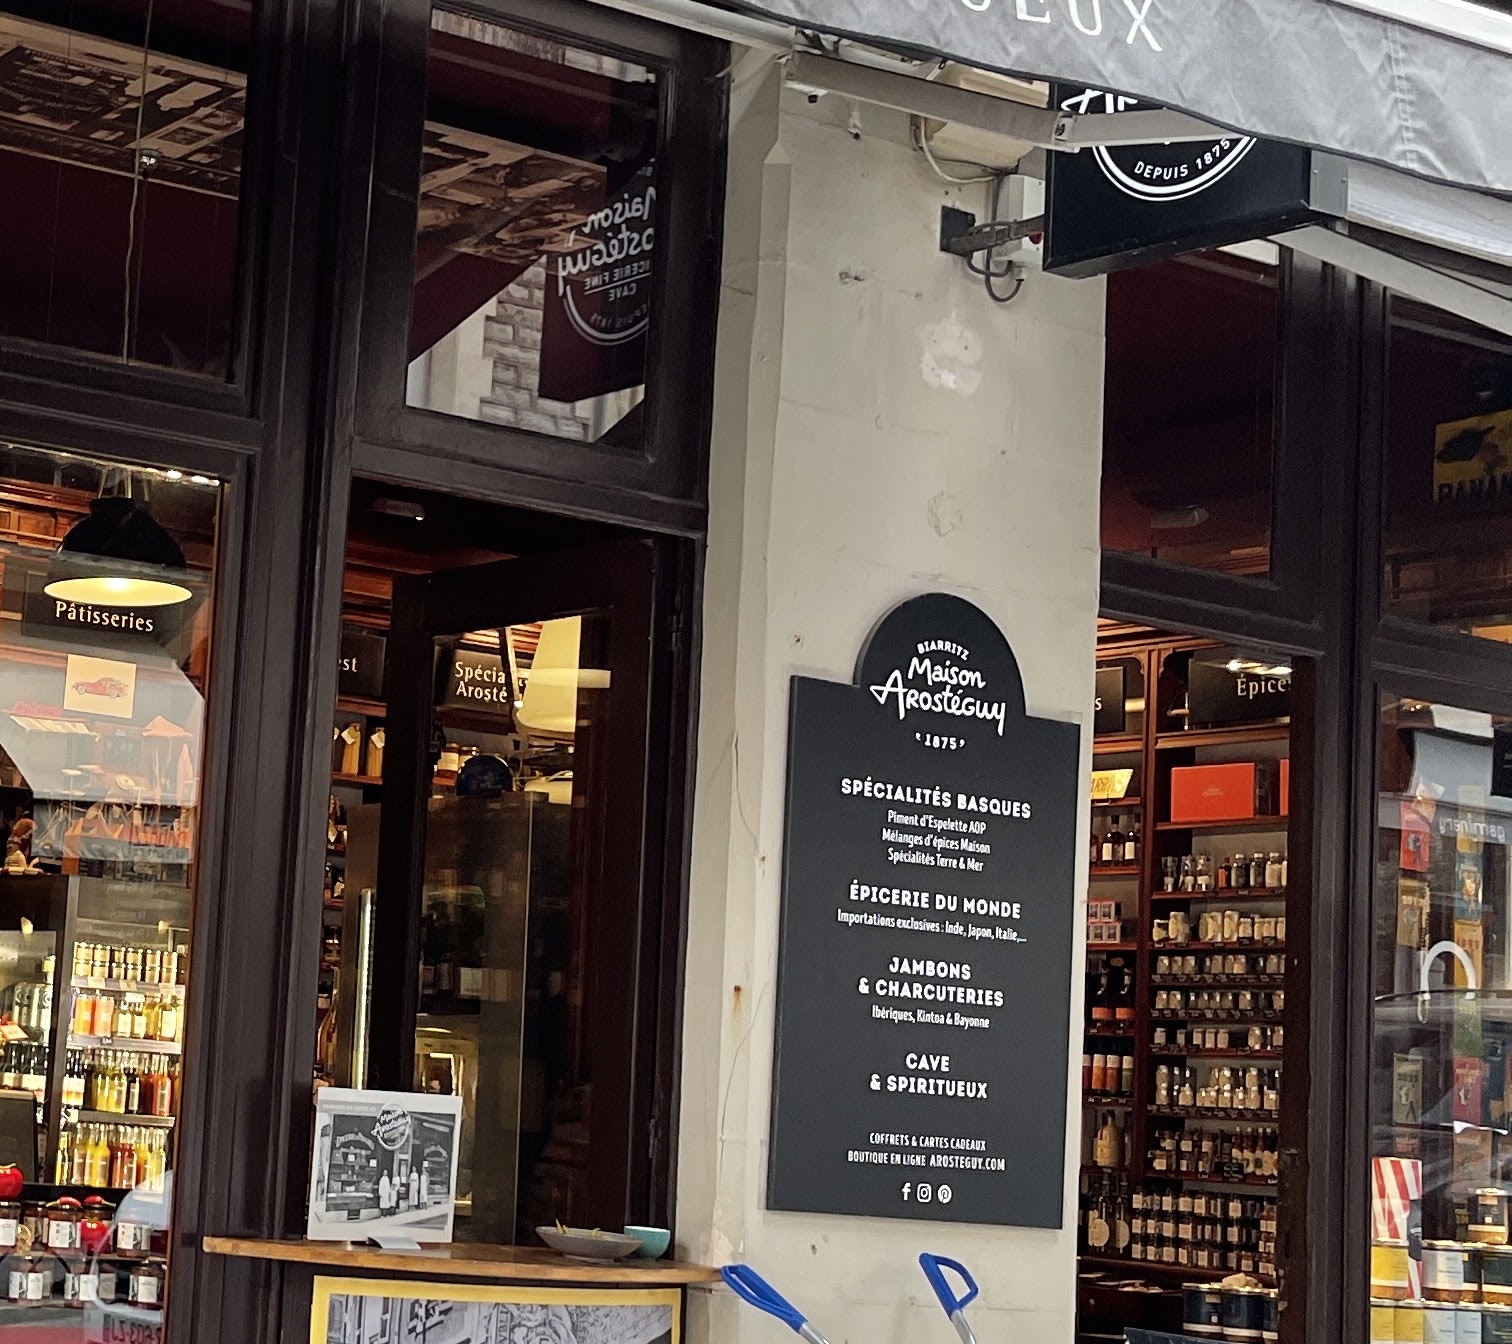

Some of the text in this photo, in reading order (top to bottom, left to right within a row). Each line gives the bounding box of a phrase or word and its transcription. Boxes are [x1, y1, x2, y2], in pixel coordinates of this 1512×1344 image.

[1134, 138, 1231, 181] DEPUIS 1875
[55, 600, 154, 632] Pâtisseries
[917, 639, 970, 661] BIARRITZ
[454, 661, 506, 684] Spécia
[908, 657, 987, 689] Maison
[455, 680, 508, 703] Arosté
[841, 776, 1032, 819] SPÉCIALITÉS BASQUES
[887, 809, 987, 835] Piment d'Espelette AOP
[882, 828, 991, 855] Mélanges d'épices Maison
[887, 847, 984, 872] Spécialités Terre & Mer
[849, 879, 1022, 920] ÉPICERIE DU MONDE
[837, 908, 896, 927] Importations
[945, 922, 967, 938] Inde,
[968, 924, 995, 941] Japon,
[889, 956, 972, 981] JAMBONS
[858, 977, 1005, 1007] & CHARCUTERIES
[872, 1004, 990, 1030] Ibériques, Kintoa & Bayonne
[905, 1052, 950, 1072] CAVE
[870, 1073, 988, 1099] & SPIRITUEUX
[869, 1132, 986, 1151] COFFRETS & CARTES CADEAUX
[847, 1150, 1006, 1171] BOUTIQUE EN LIGNE AROSTEGUY.COM
